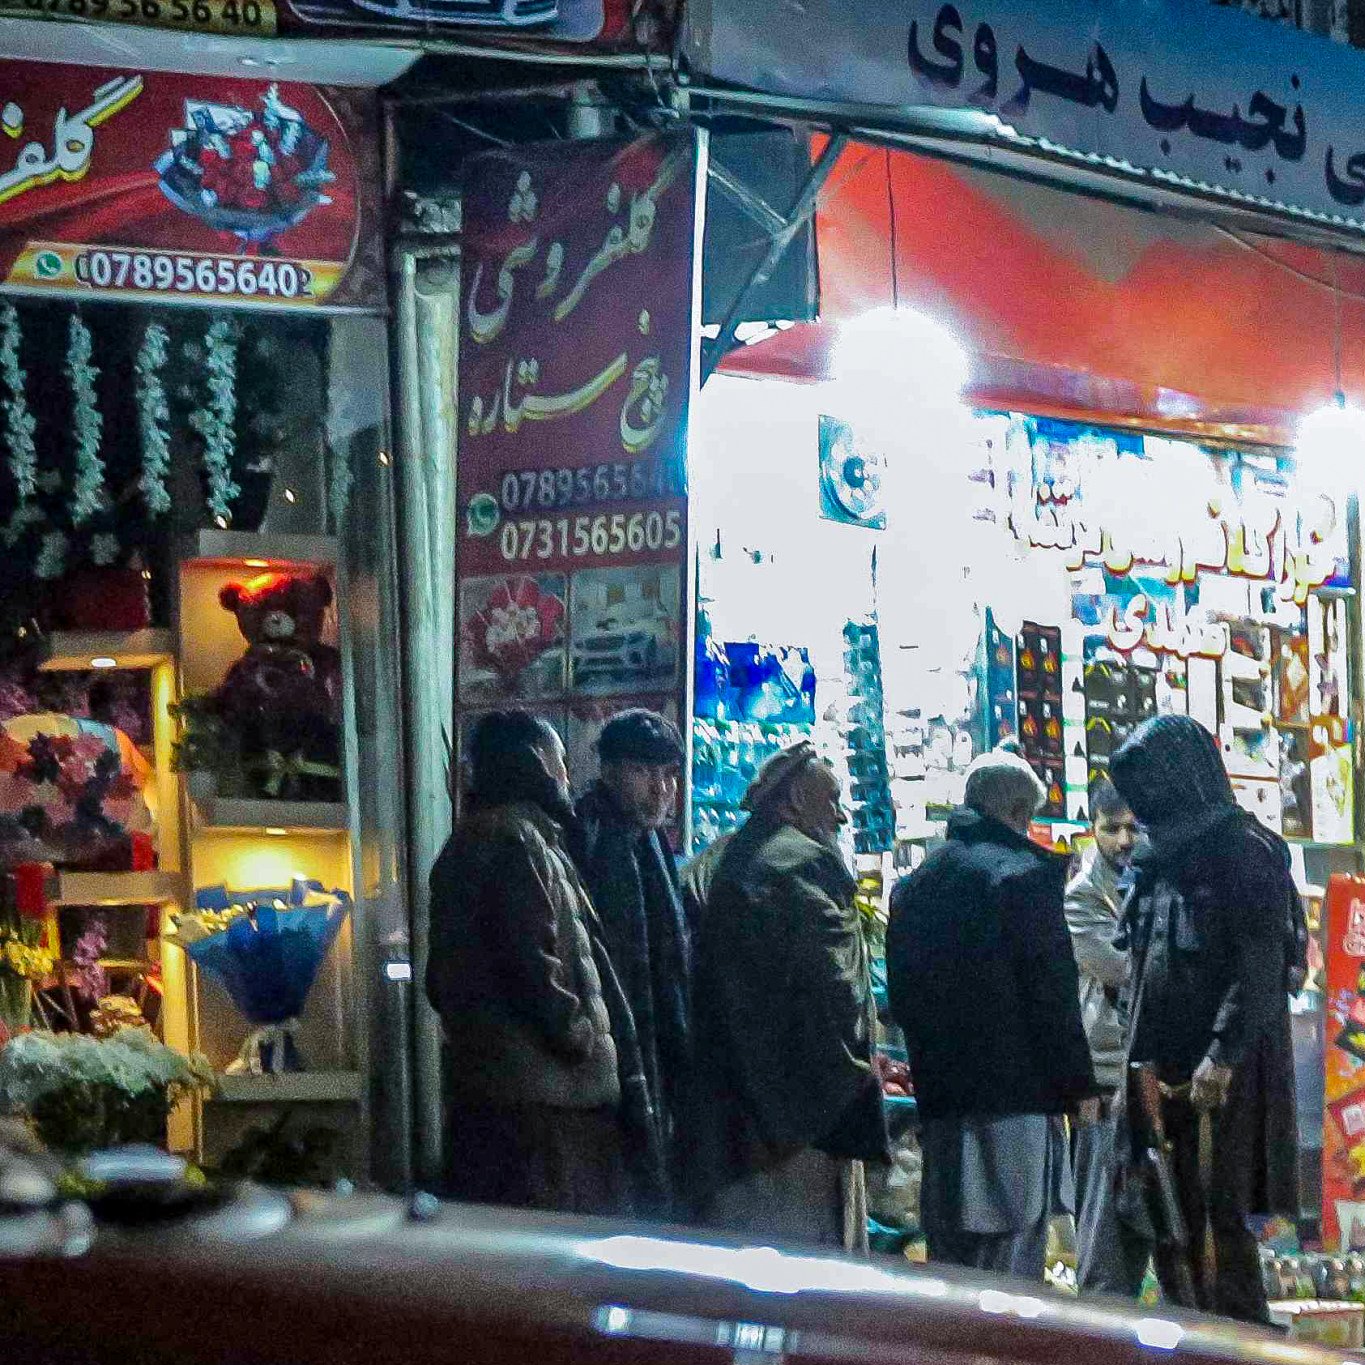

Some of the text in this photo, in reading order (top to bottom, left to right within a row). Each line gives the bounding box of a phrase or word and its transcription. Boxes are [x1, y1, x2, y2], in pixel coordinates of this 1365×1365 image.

[907, 2, 1119, 120] هروی
[1140, 74, 1307, 186] نجیب
[90, 251, 299, 299] 0789565640
[468, 150, 682, 344] گلفروشی
[468, 351, 629, 436] ستاره
[500, 511, 682, 561] 0731565605
